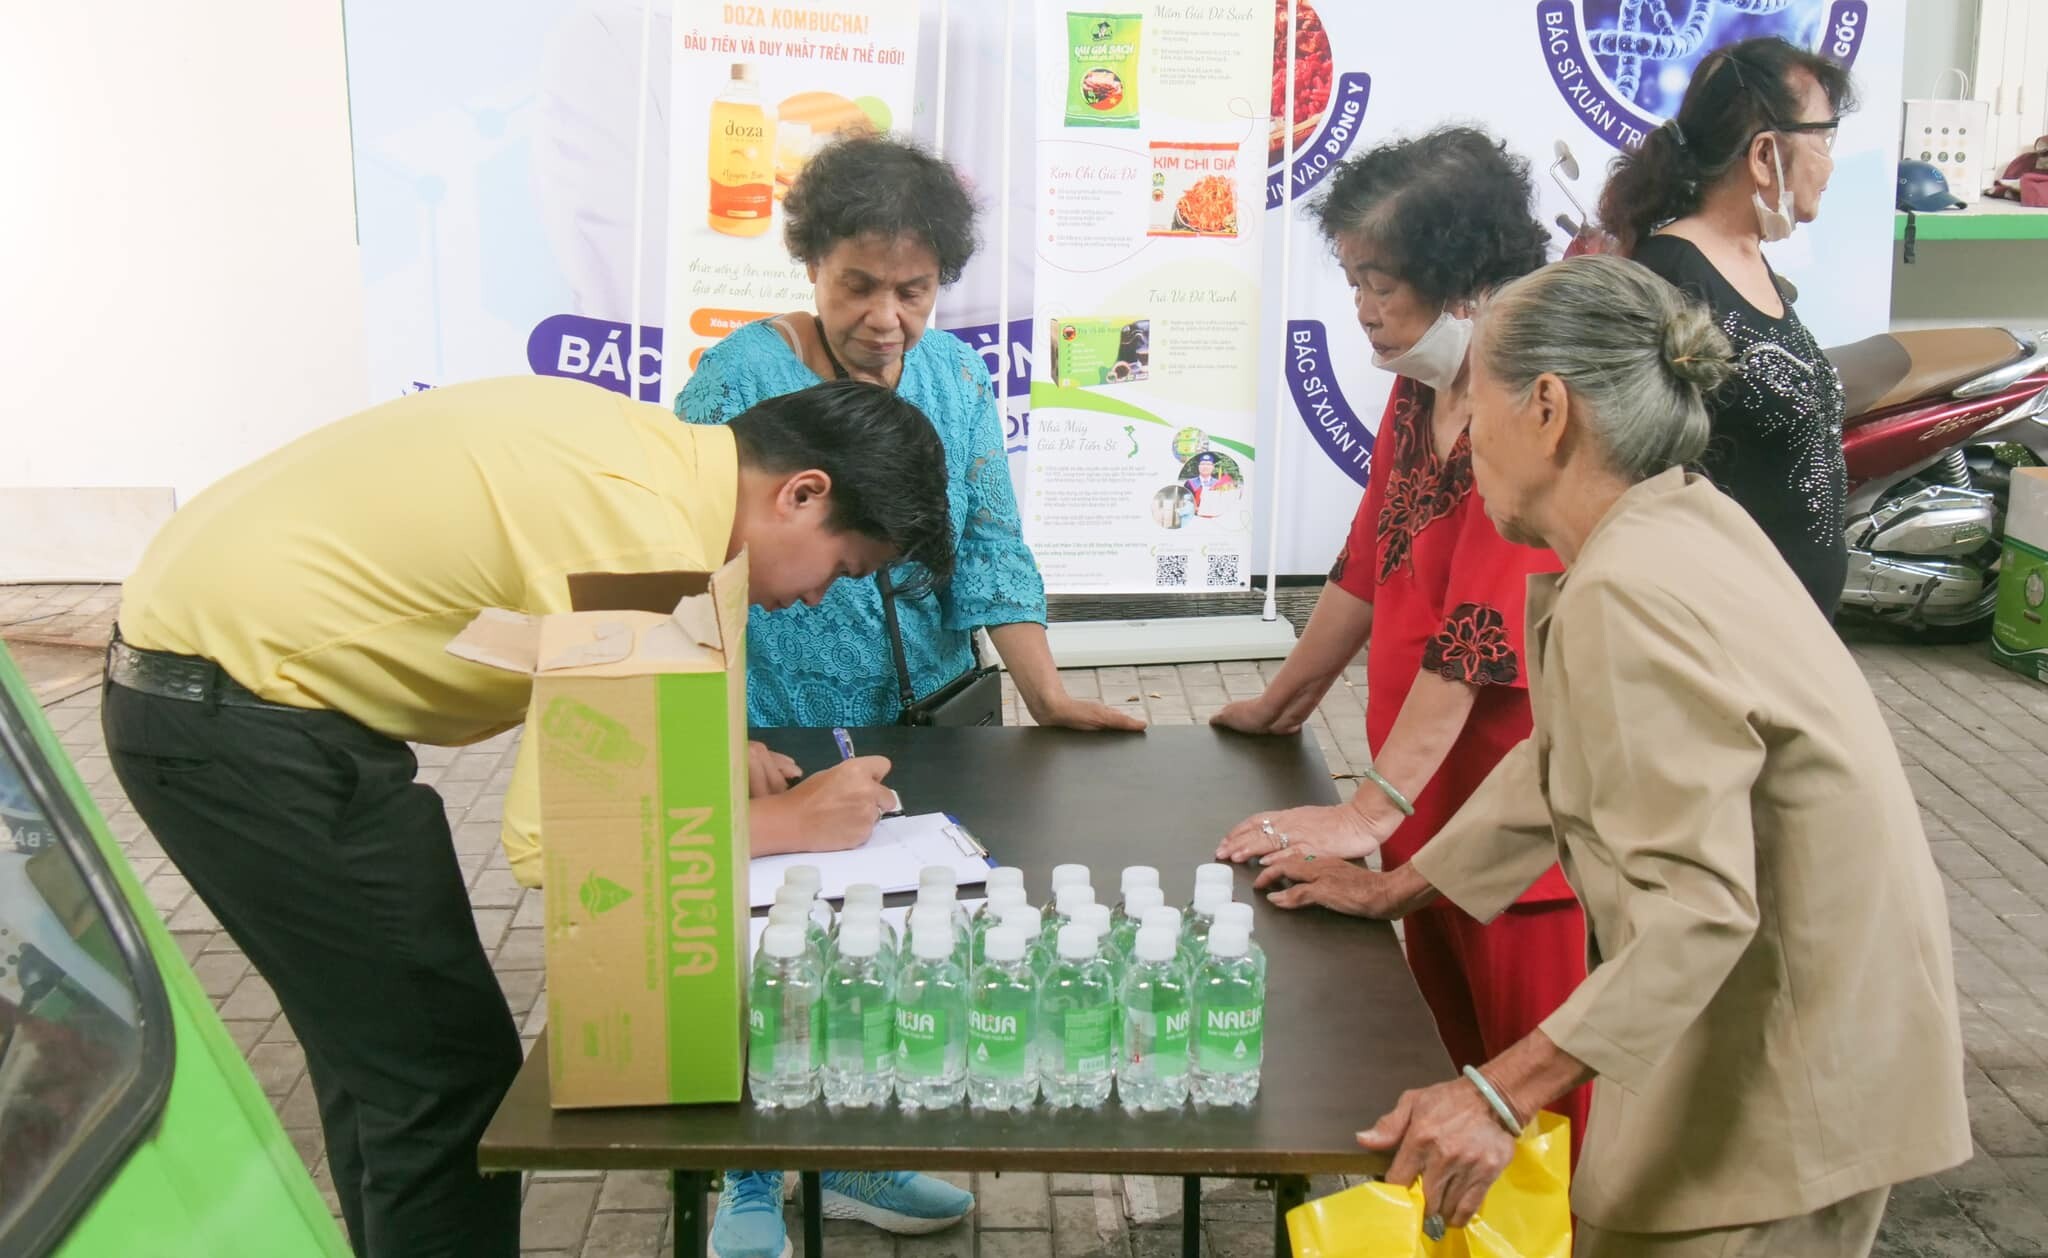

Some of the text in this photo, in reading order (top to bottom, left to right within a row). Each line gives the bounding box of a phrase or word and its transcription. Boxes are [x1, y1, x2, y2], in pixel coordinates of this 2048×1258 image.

[723, 4, 869, 34] DOZA KOMBUCHA!
[1545, 11, 1568, 55] BÁC
[1833, 11, 1859, 57] GỐC
[684, 29, 905, 65] ĐẦU TIÊN VÀ DUY NHẤT TRÊN THẾ GIỚI!
[1558, 58, 1583, 80] SĨ
[1568, 79, 1617, 131] XUÂN
[725, 119, 763, 137] doza
[1292, 154, 1328, 185] VÀO
[1325, 101, 1360, 154] ĐÔNG
[1348, 81, 1364, 95] Y
[1153, 155, 1236, 171] KIM CHI GIÁ
[557, 329, 663, 385] BÁC
[1293, 330, 1317, 373] BÁC
[1303, 377, 1328, 397] SĨ
[1312, 397, 1356, 453] XUÂN
[667, 806, 719, 977] NAWA
